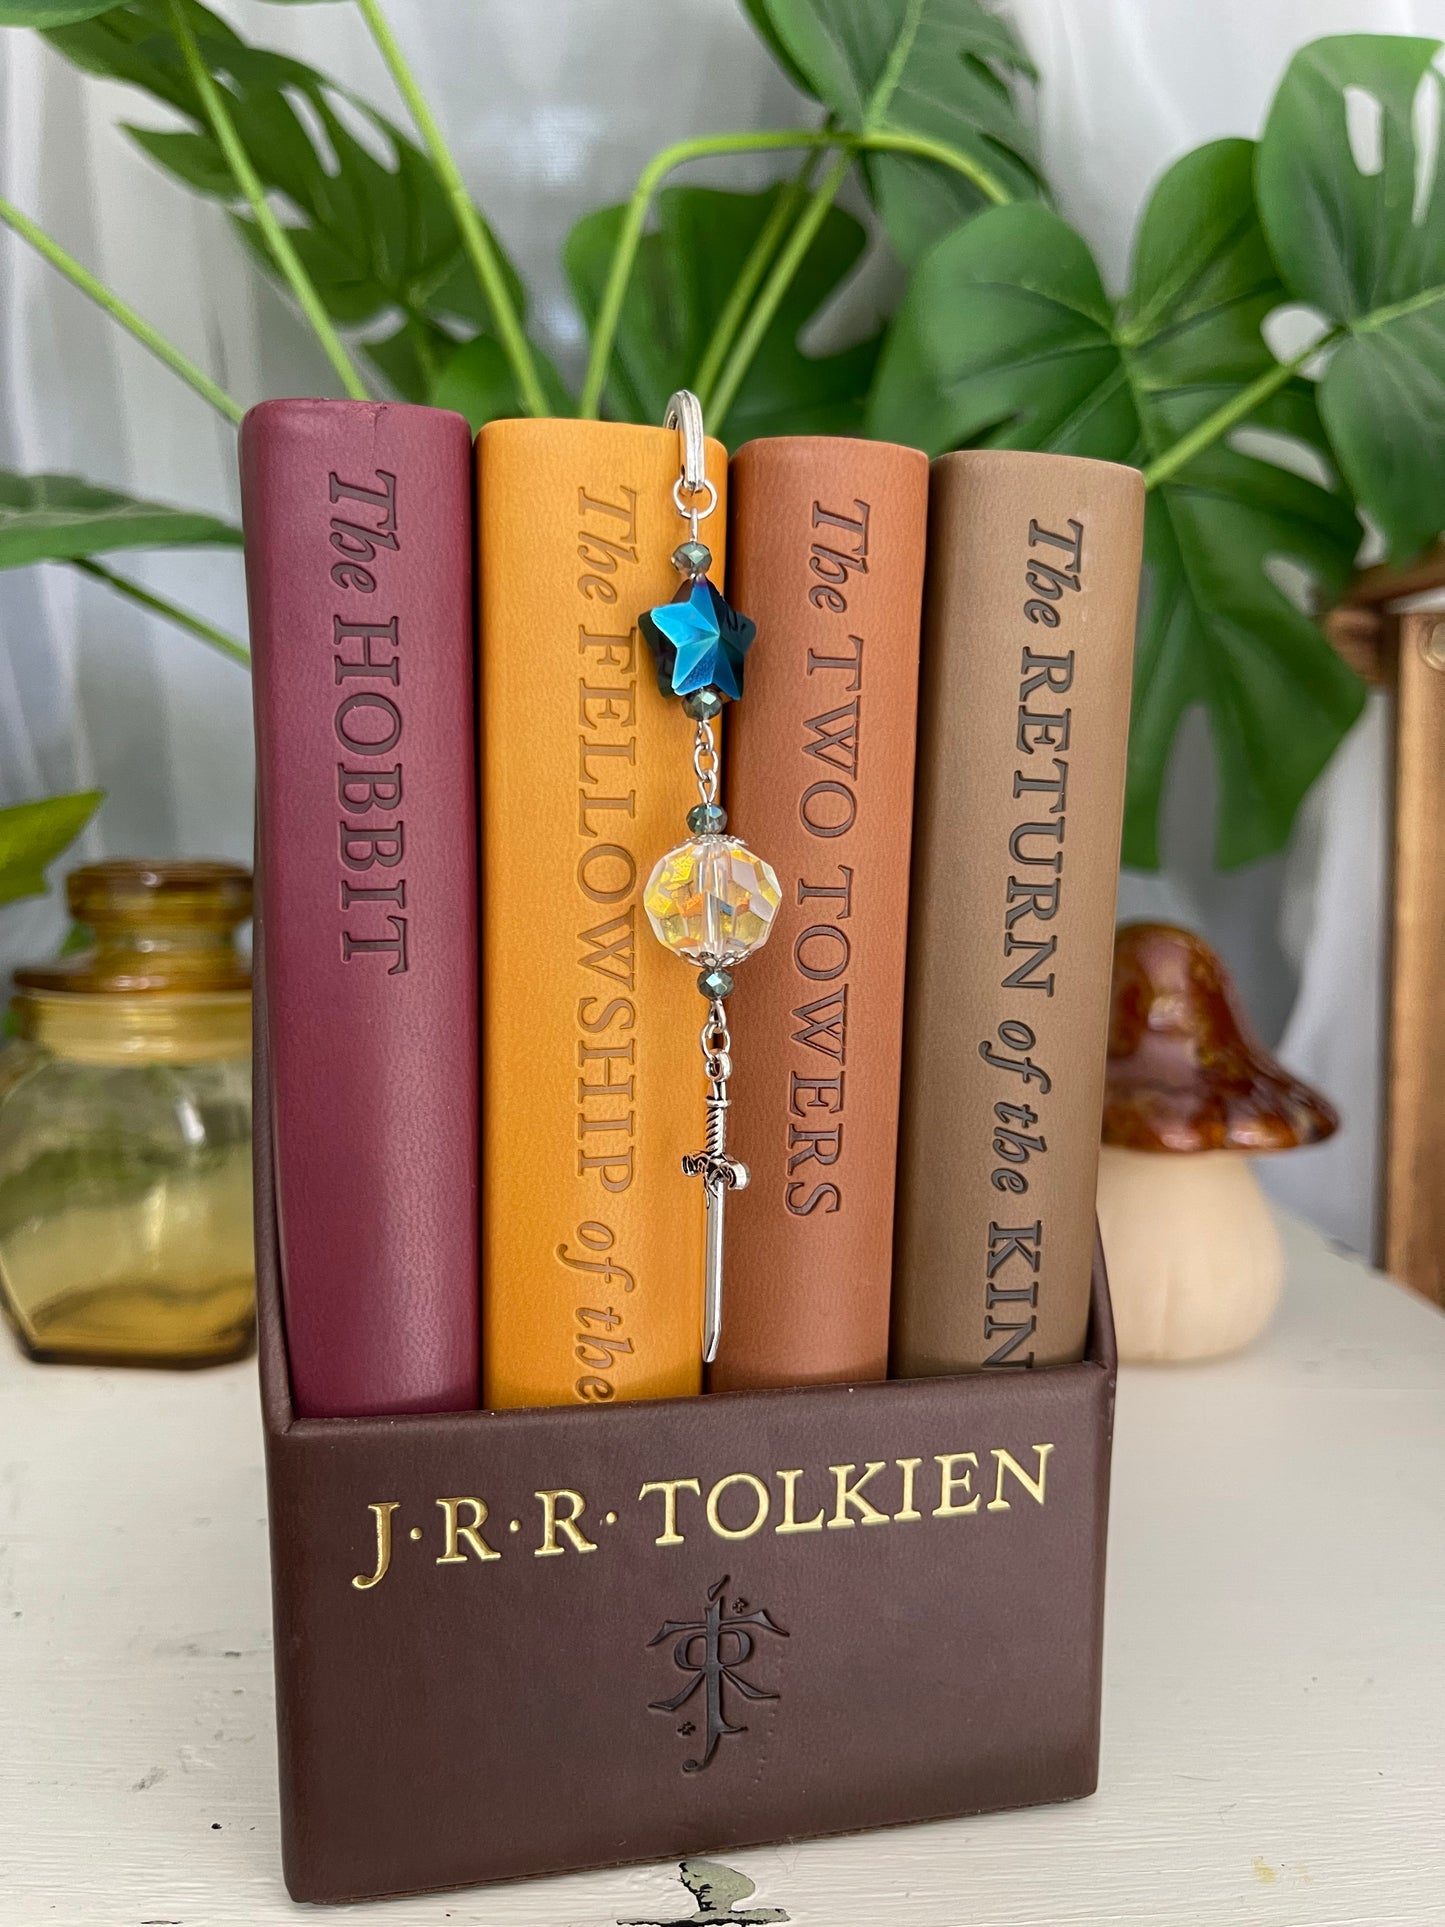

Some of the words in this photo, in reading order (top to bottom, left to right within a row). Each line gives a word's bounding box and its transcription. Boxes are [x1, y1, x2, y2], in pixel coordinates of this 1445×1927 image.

[329, 469, 399, 594] The
[578, 485, 638, 604] The
[809, 499, 870, 613] The
[1023, 518, 1084, 628] The
[800, 634, 864, 838] TWO
[332, 614, 410, 976] HOBBIT
[1001, 646, 1075, 998] RETURN
[577, 624, 638, 1193] FELLOWSHIP
[785, 864, 854, 1217] TOWERS
[979, 1020, 1052, 1094] of
[991, 1101, 1047, 1194] the
[556, 1221, 635, 1293] of
[574, 1306, 635, 1402] the
[638, 1443, 1055, 1546] TOLKIEN
